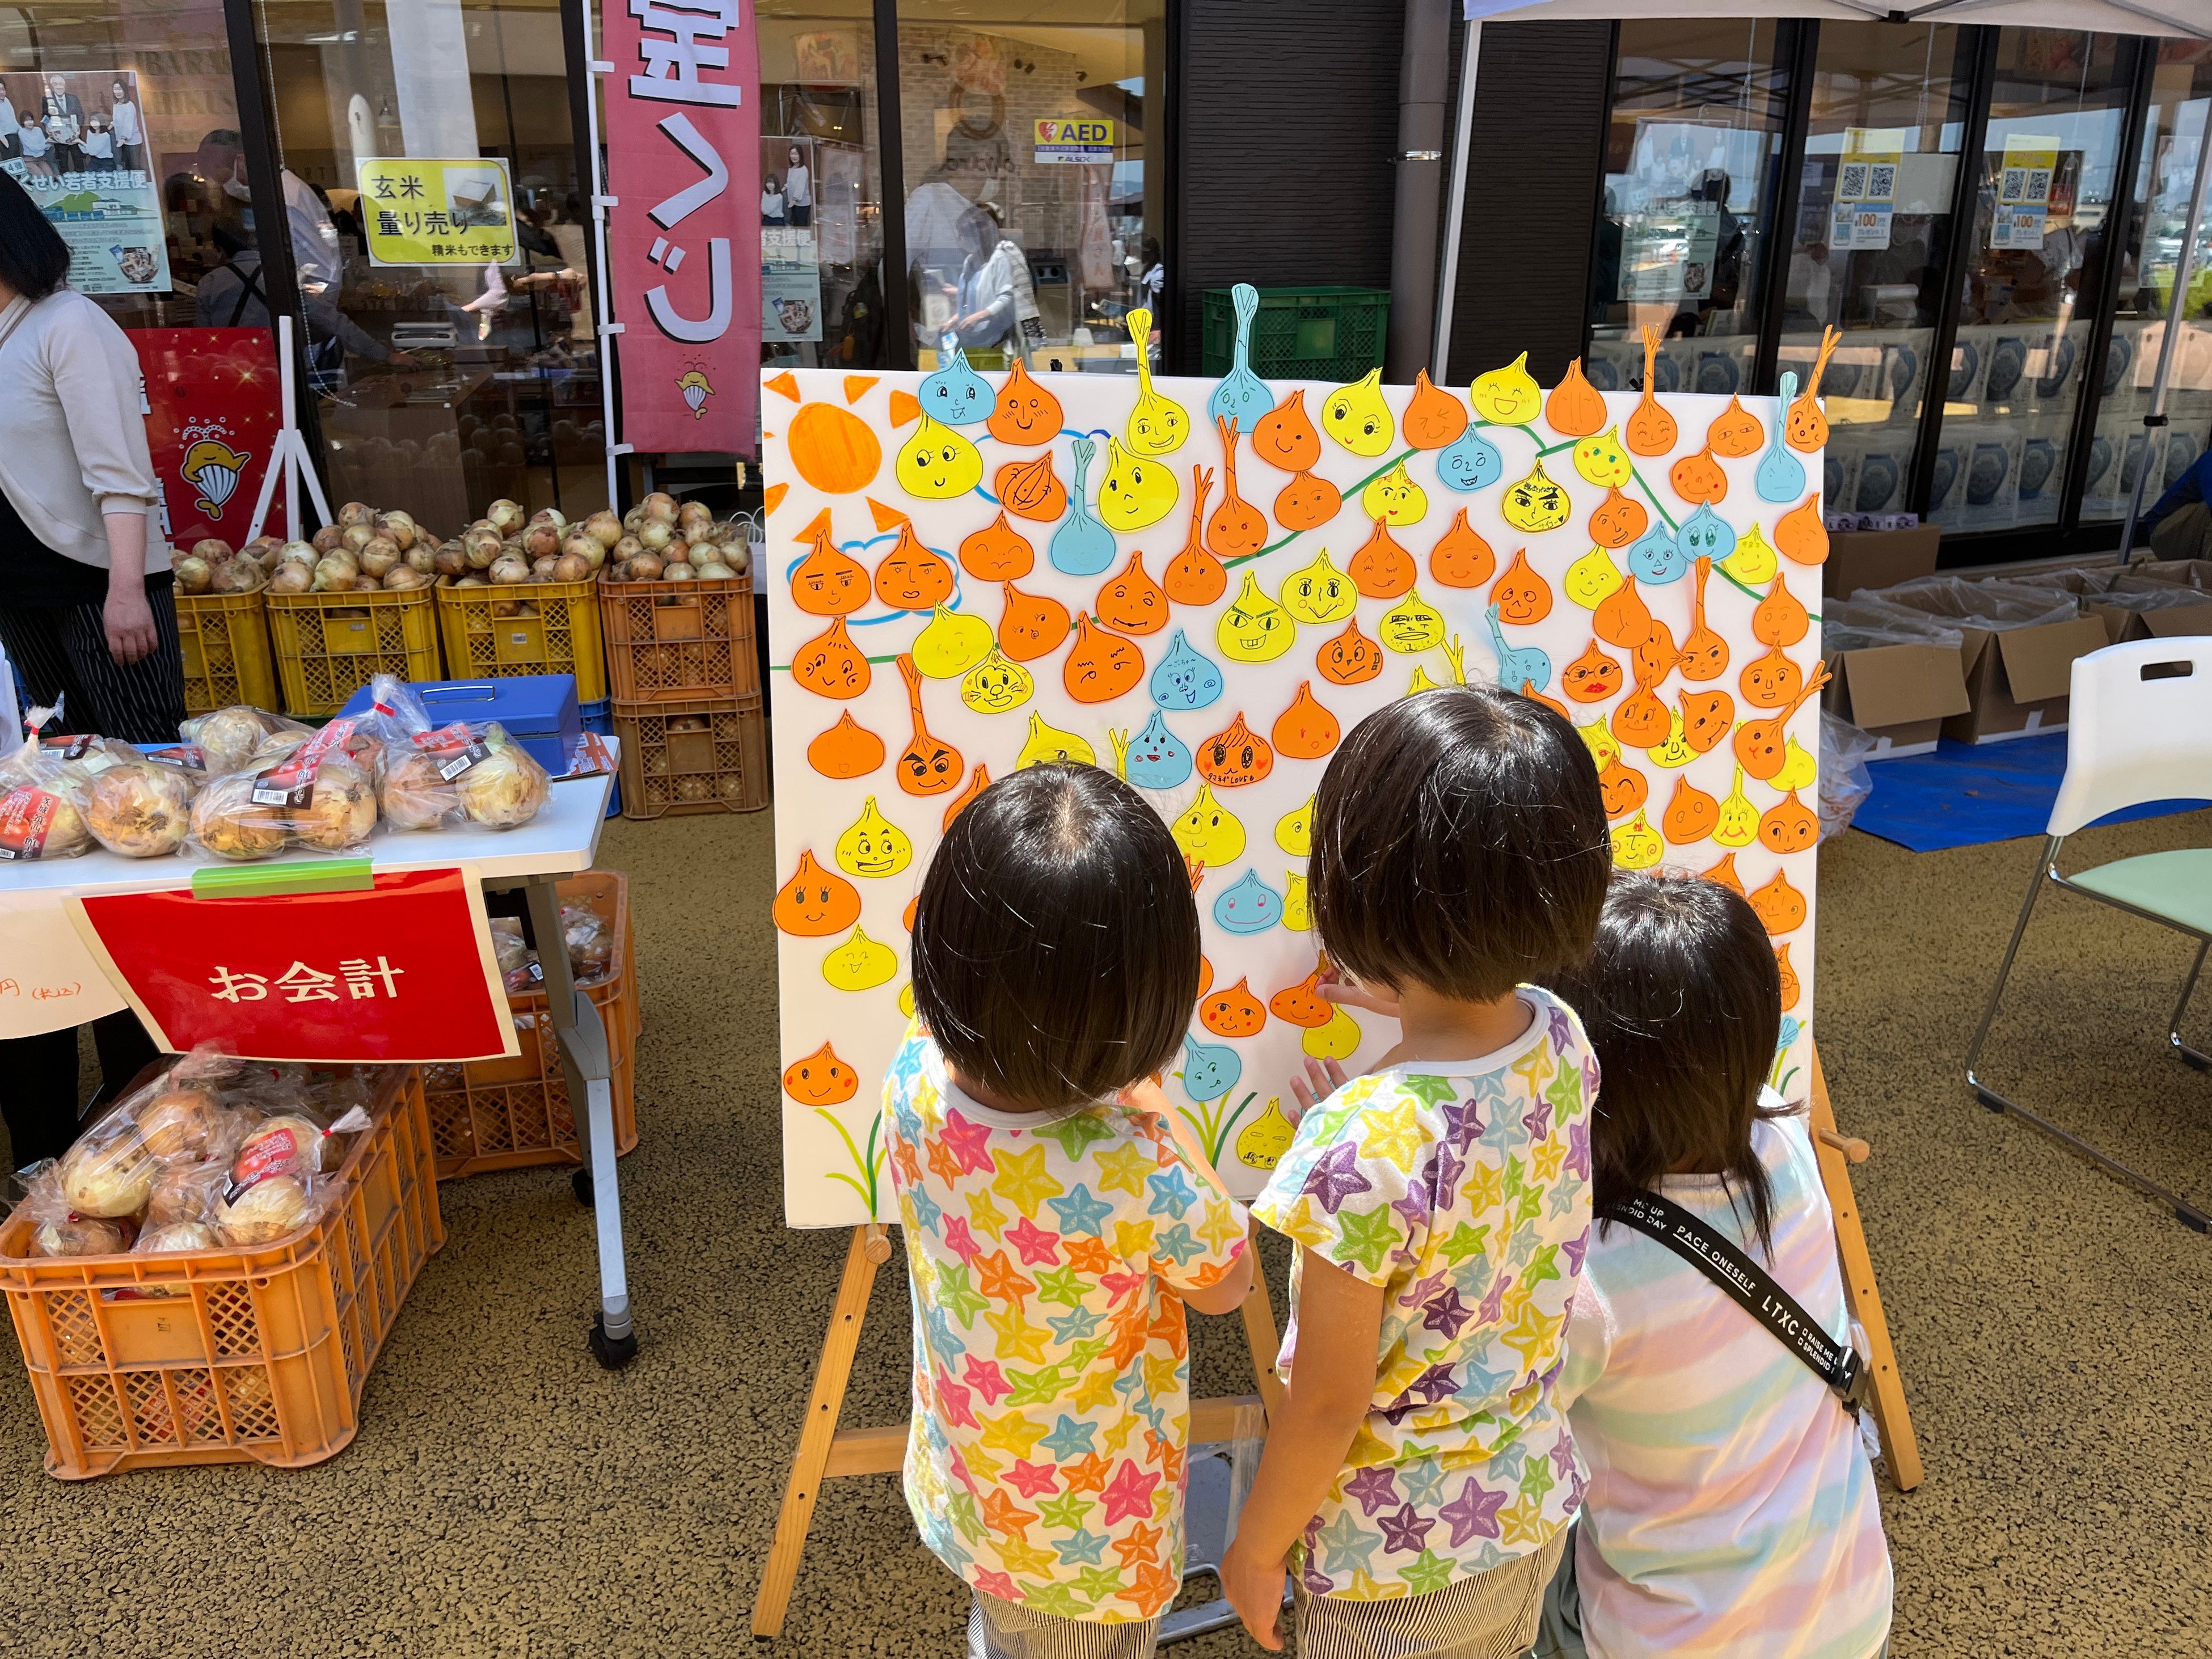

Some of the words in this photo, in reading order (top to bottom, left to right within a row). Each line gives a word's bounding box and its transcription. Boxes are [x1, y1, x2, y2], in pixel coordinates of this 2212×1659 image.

[1061, 124, 1108, 141] AED
[371, 175, 425, 200] 玄米
[377, 210, 468, 236] 量り売り
[208, 956, 405, 1003] お会計
[1646, 1215, 1668, 1231] DAY
[1650, 1206, 1665, 1217] UP
[1677, 1225, 1709, 1253] PACE
[1711, 1251, 1757, 1290] ONESELF
[1761, 1294, 1799, 1336] LTXC
[1802, 1341, 1831, 1371] SPLENDID
[1807, 1332, 1825, 1353] RAISE
[1823, 1348, 1835, 1361] ME
